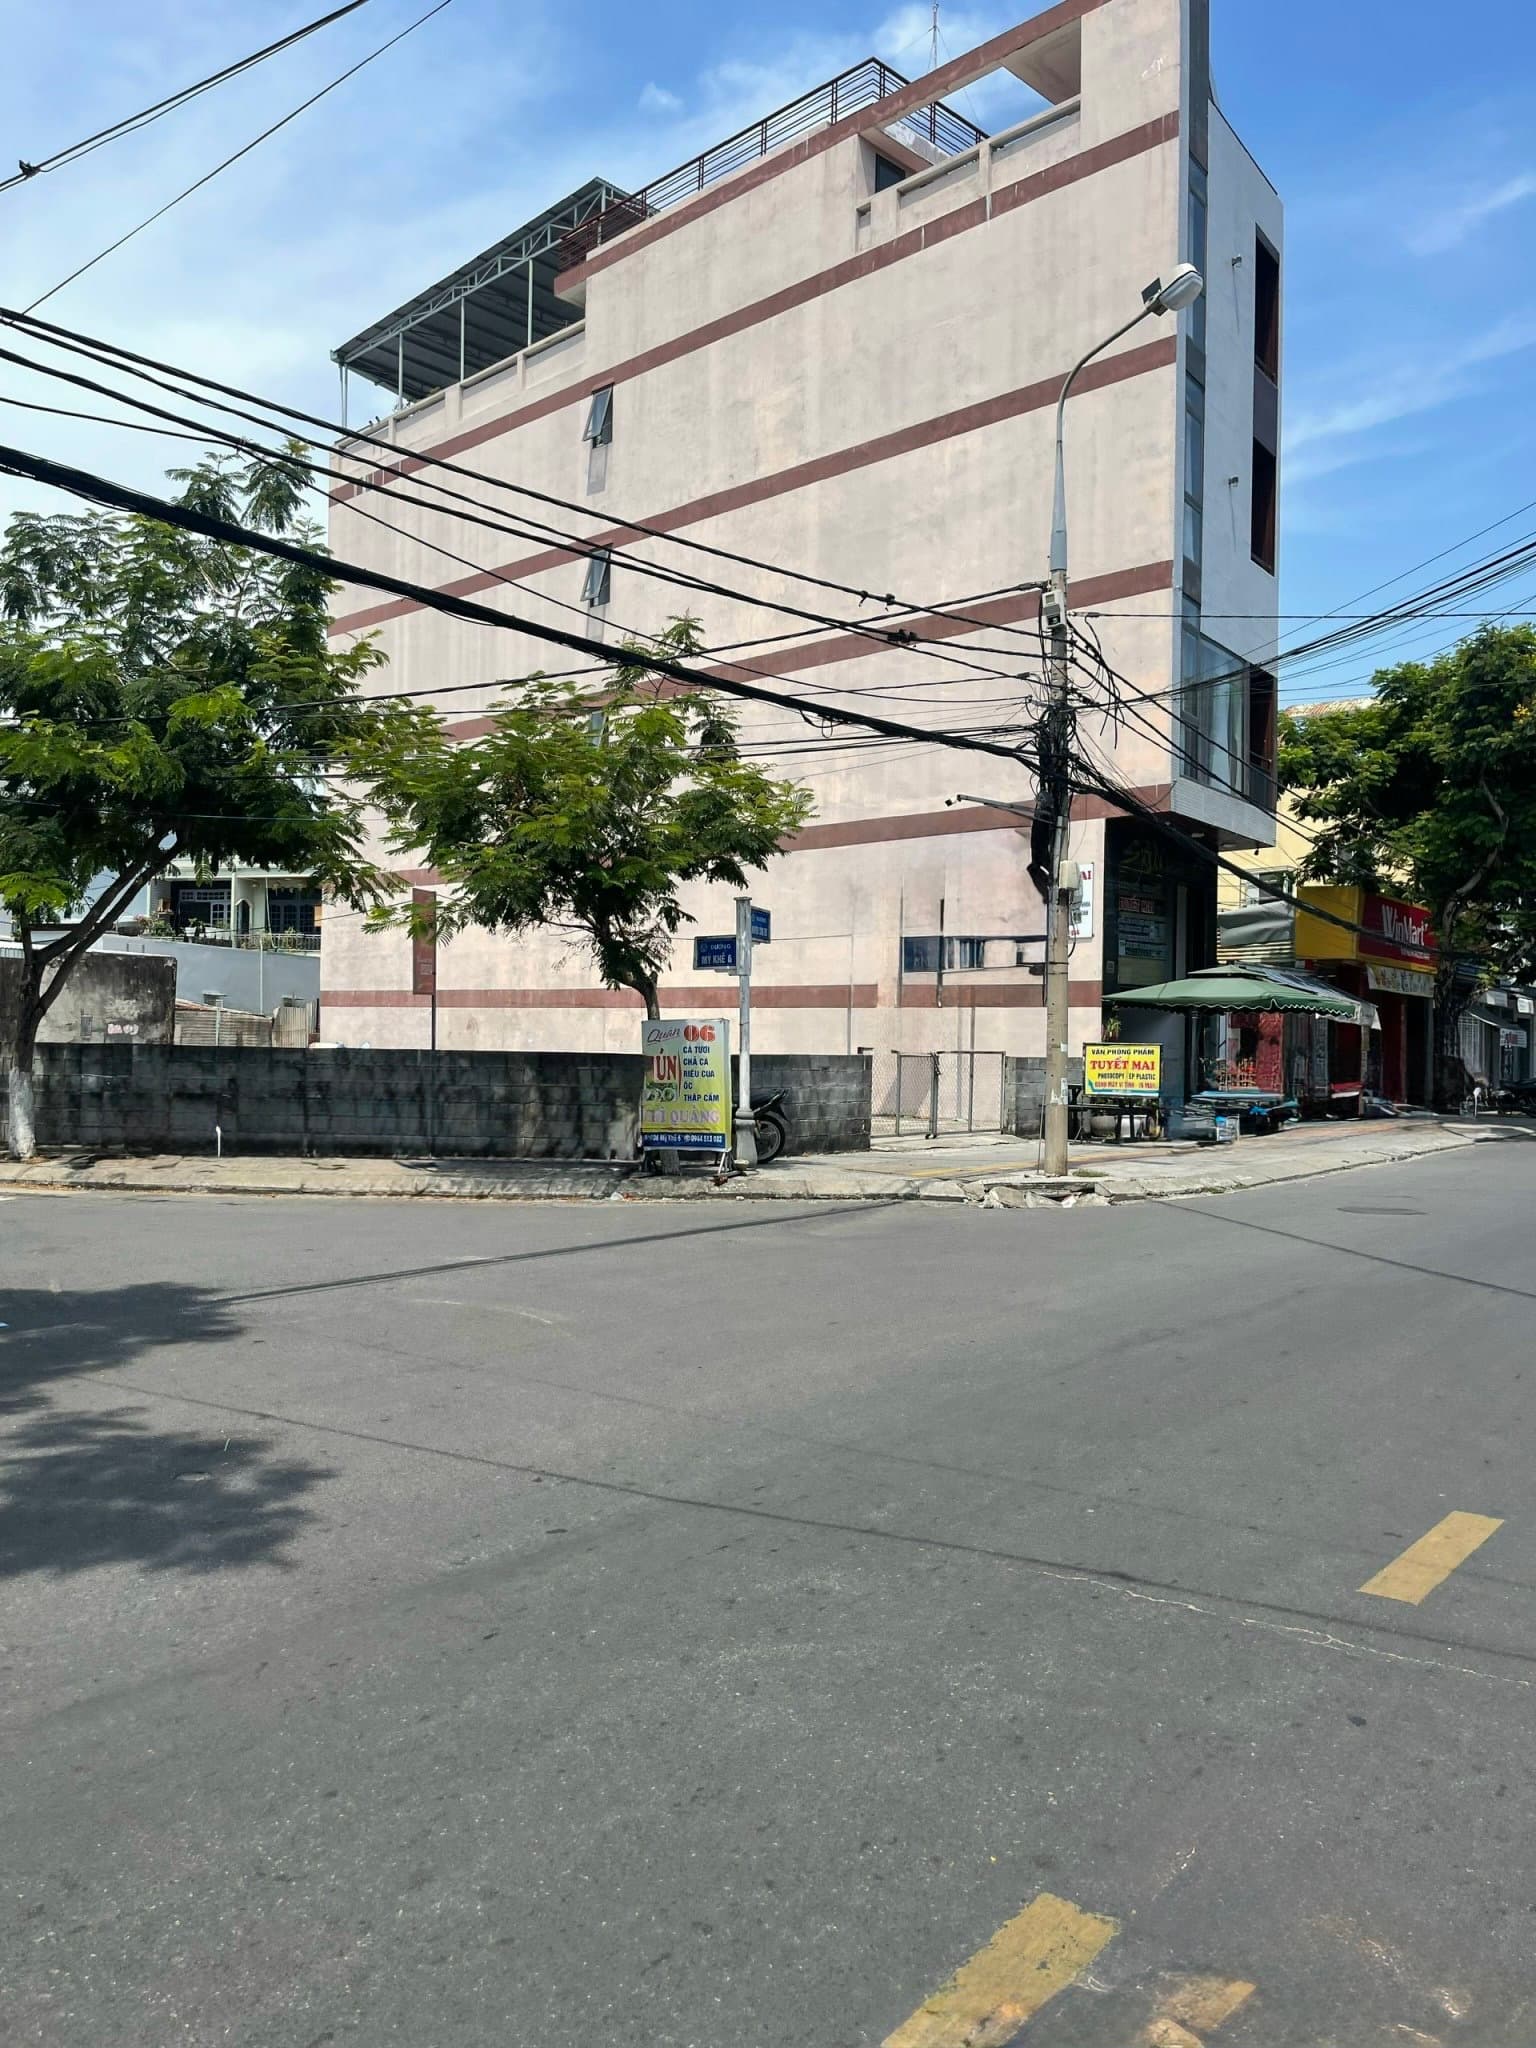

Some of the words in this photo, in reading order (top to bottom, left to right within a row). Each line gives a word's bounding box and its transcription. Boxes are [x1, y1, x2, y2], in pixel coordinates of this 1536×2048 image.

[684, 1025, 716, 1042] 06
[651, 1047, 677, 1080] ÚN
[1090, 1056, 1129, 1070] TUYẾT
[1132, 1060, 1155, 1070] MAI
[701, 1070, 715, 1078] CUA
